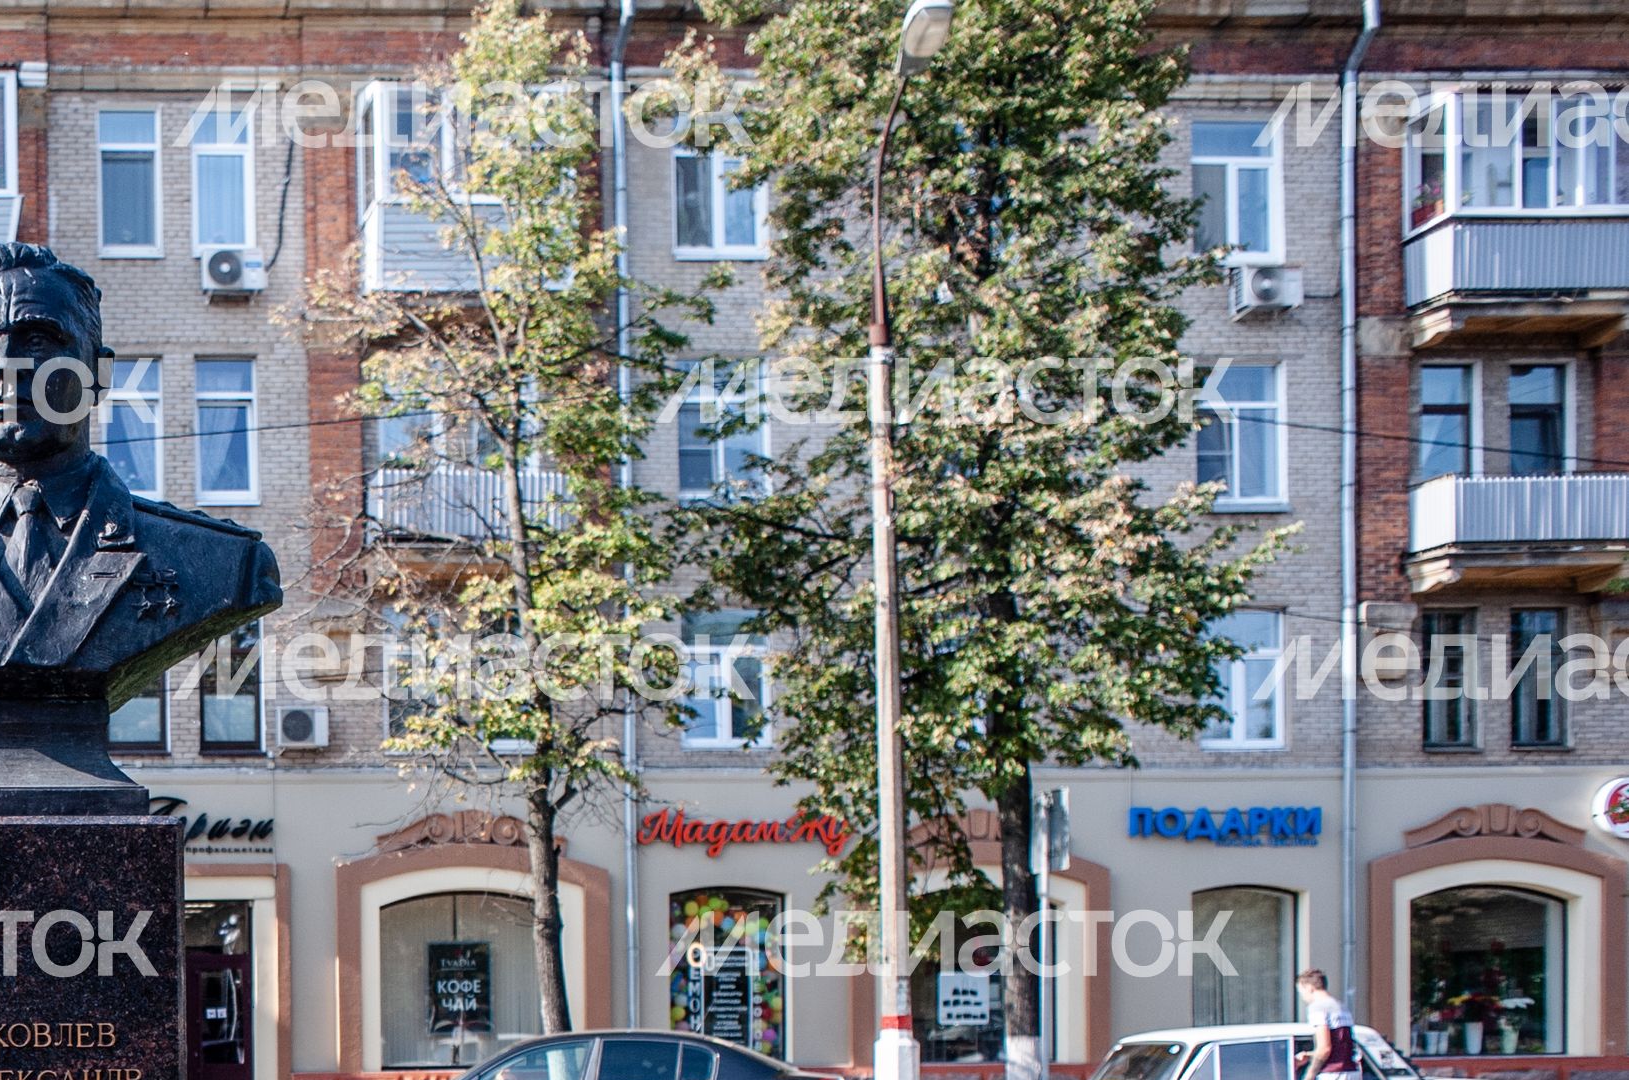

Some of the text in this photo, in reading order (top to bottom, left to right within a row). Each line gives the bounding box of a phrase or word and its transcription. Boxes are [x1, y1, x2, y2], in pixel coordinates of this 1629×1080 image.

[1129, 807, 1322, 842] ПОДАРКИ
[437, 979, 481, 994] КОФЕ
[441, 994, 477, 1012] ЧАЙ
